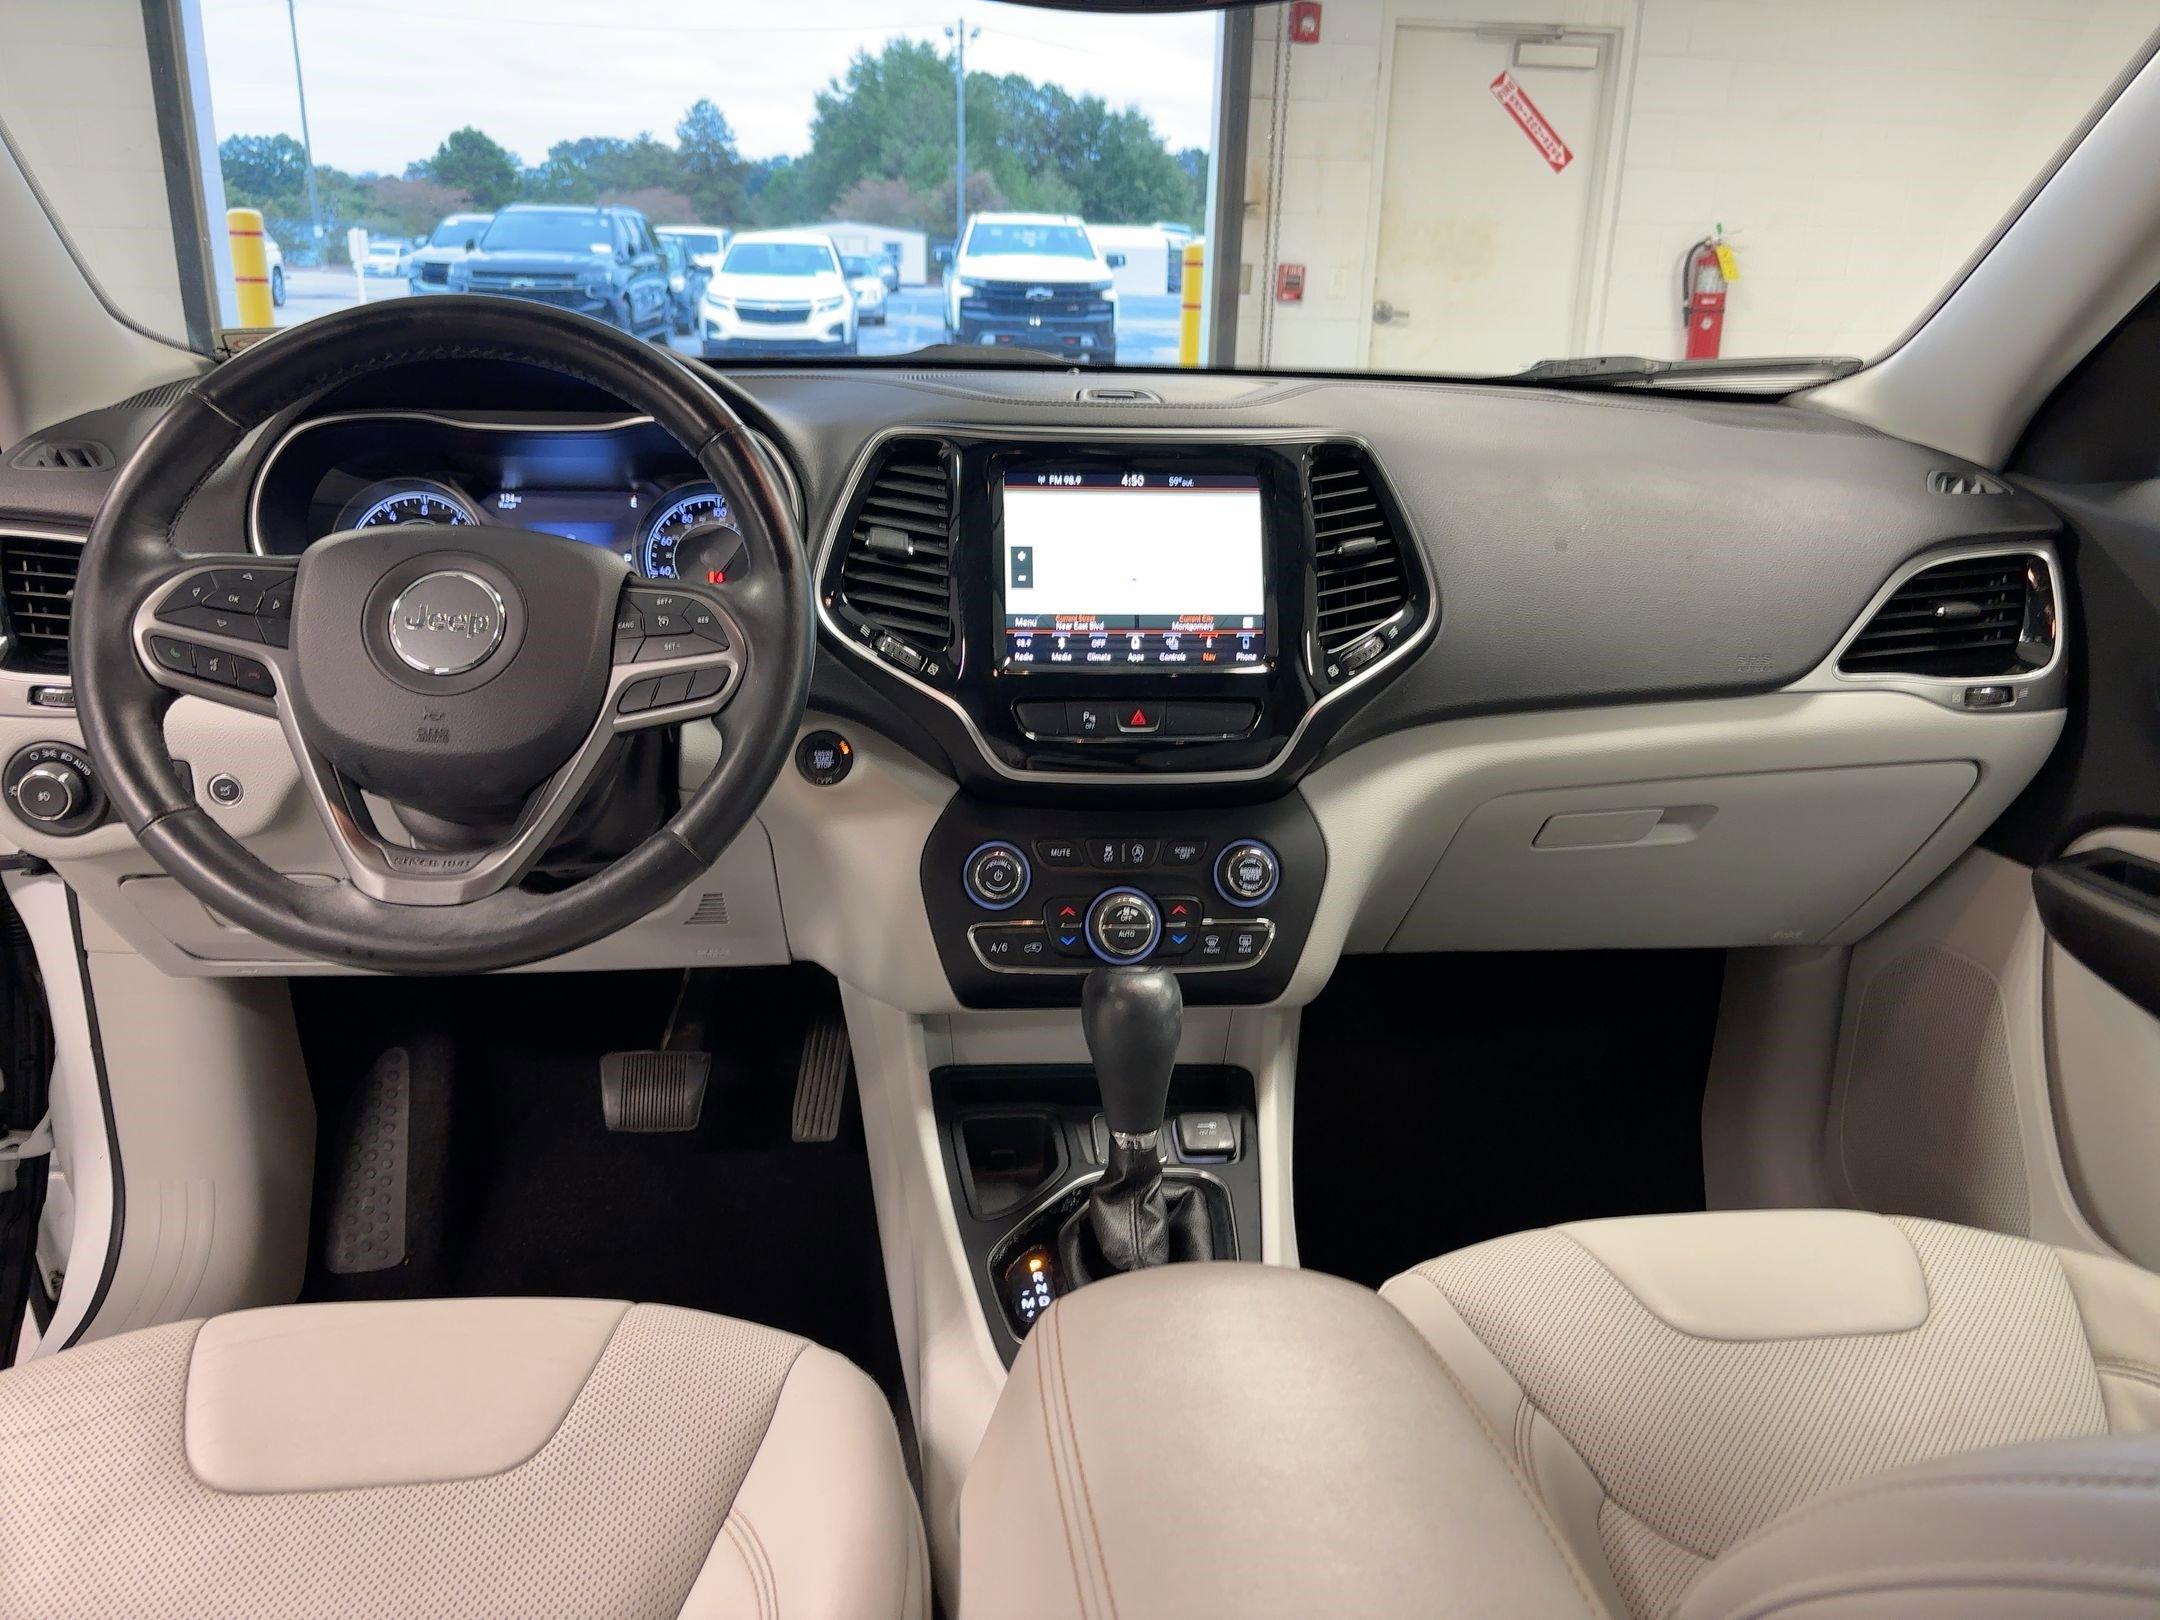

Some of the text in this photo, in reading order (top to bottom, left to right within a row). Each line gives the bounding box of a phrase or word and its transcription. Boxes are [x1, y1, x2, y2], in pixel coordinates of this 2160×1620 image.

[1049, 475, 1082, 486] FM 98.9
[1121, 473, 1145, 487] 4:50
[713, 507, 727, 518] 100
[681, 513, 693, 524] 80
[660, 536, 672, 547] 60
[659, 566, 672, 577] 40
[228, 594, 240, 604] OK
[404, 603, 490, 638] Jeep
[697, 616, 710, 624] RES
[1015, 617, 1038, 628] Menu
[1179, 615, 1200, 623] Current
[1056, 621, 1105, 630] Near East Blvd
[1171, 621, 1215, 632] Montgomery
[1016, 638, 1032, 648] 98.9
[1014, 651, 1034, 661] Radio
[1051, 651, 1073, 661] Media
[1087, 651, 1112, 662] Climate
[1127, 652, 1145, 663] Apps
[1159, 652, 1187, 662] Controls
[1202, 652, 1217, 662] Nav
[1236, 651, 1258, 662] Phone
[73, 758, 91, 776] AUTO
[1050, 847, 1071, 858] MUTE
[1174, 846, 1196, 856] SCREEN
[1179, 852, 1190, 861] OFF
[1103, 855, 1113, 863] OFF
[1120, 913, 1133, 922] OFF
[1118, 929, 1136, 938] AUTO
[1032, 1271, 1044, 1283] R
[1035, 1282, 1048, 1295] N
[1021, 1296, 1036, 1310] M
[1038, 1295, 1051, 1307] D
